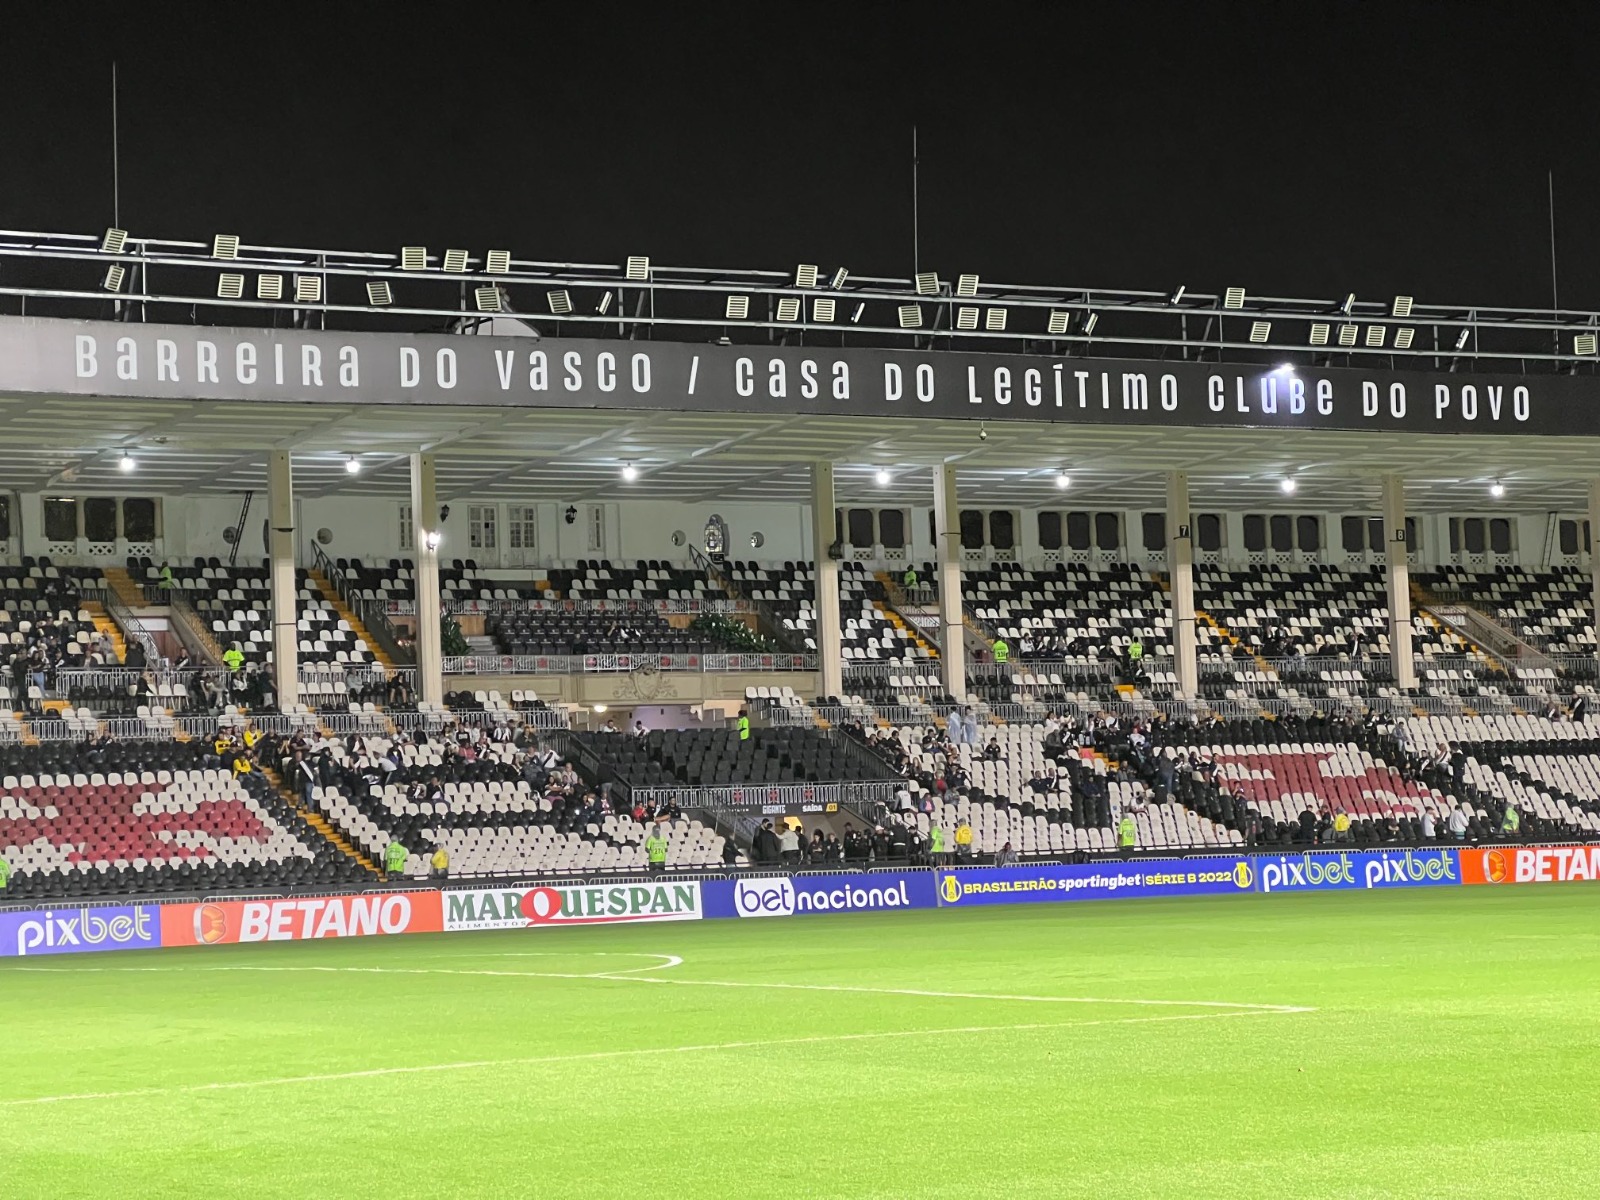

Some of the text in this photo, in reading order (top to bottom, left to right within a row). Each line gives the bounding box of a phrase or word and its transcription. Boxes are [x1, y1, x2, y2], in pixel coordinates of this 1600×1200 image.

[399, 347, 457, 389] DO
[884, 362, 935, 403] DO
[1362, 381, 1407, 419] DO
[1435, 384, 1530, 421] POVO
[802, 803, 823, 812] SAÍDA
[963, 871, 1232, 894] BRASILEIRÃO sportingbet SÉRIE B 2022
[1263, 849, 1456, 892] pixbet pixbet
[447, 886, 695, 927] MARQUESPAN
[740, 880, 910, 912] bet nacional
[17, 904, 152, 955] pixbet
[238, 895, 412, 943] BETANO
[447, 920, 527, 930] ALIMENTOS
